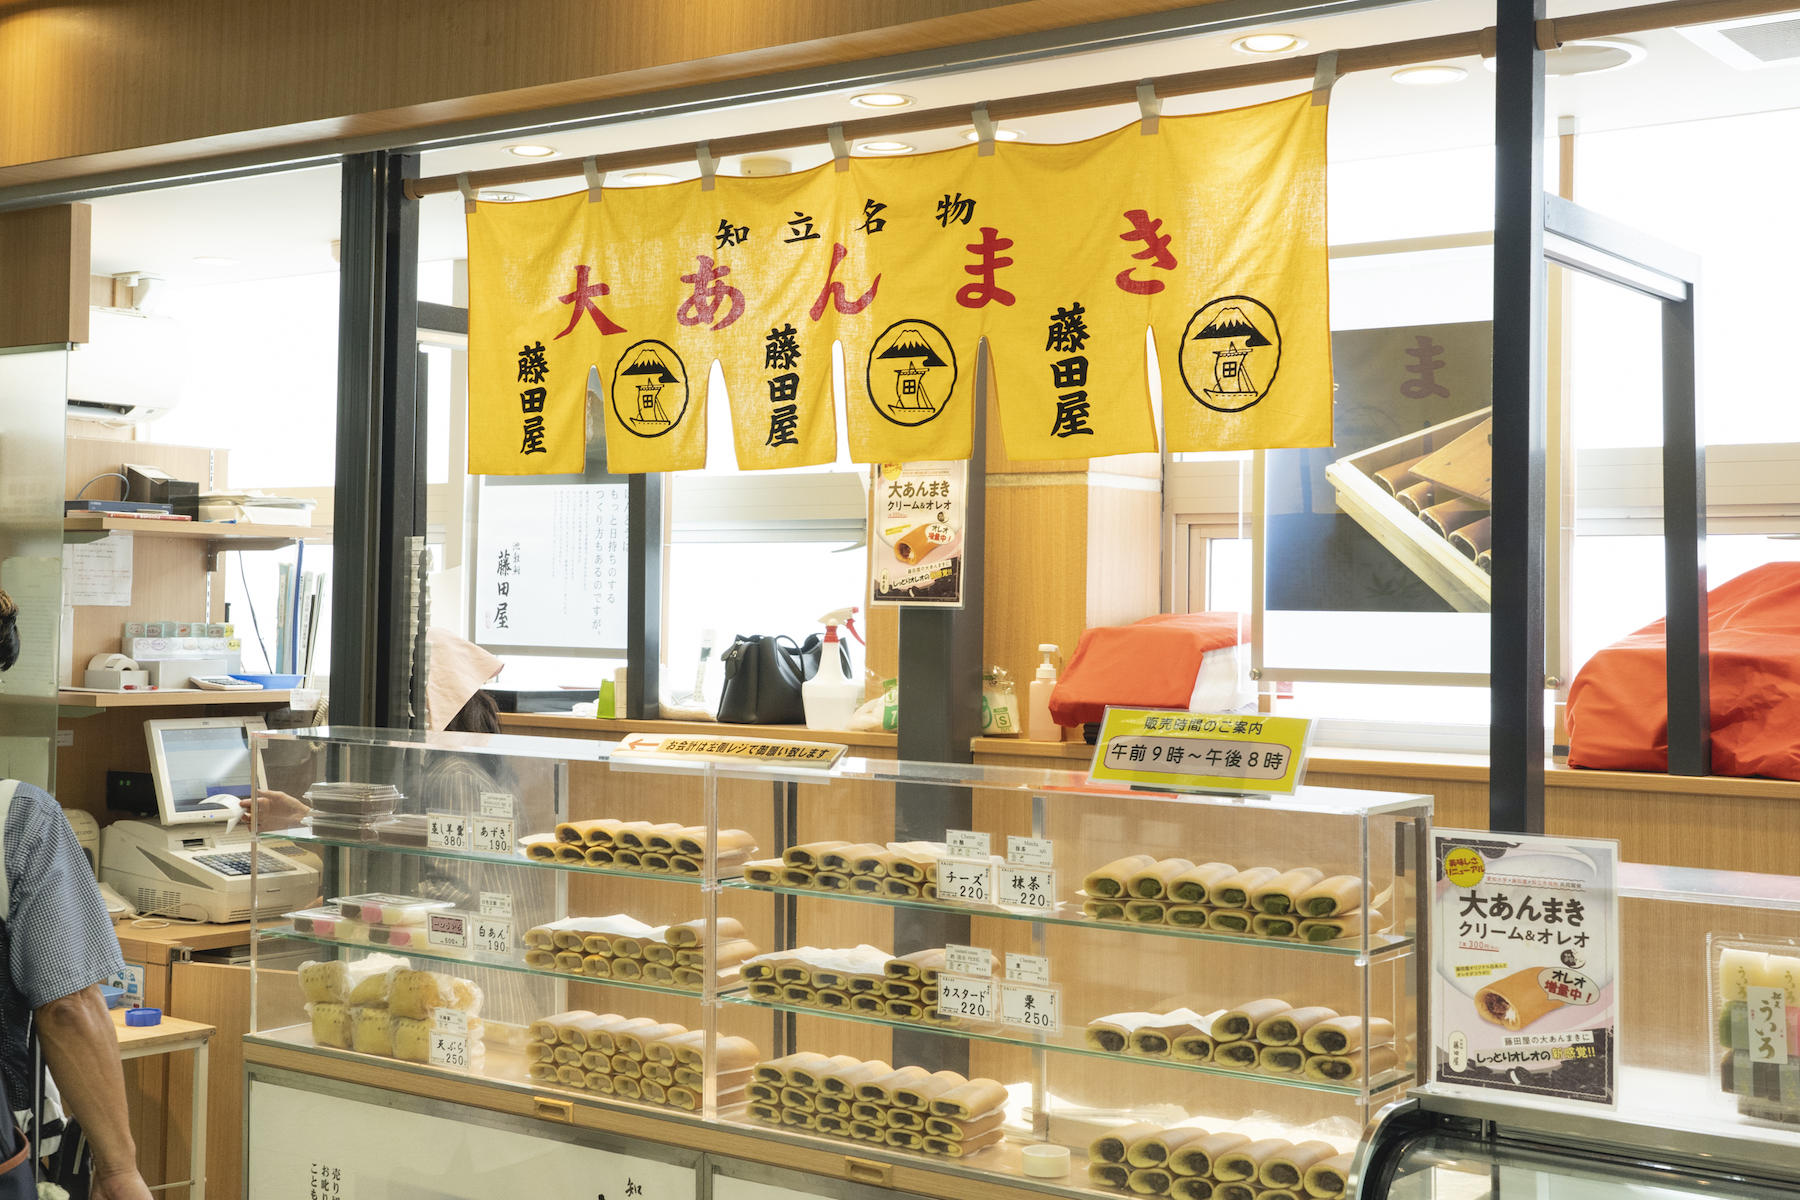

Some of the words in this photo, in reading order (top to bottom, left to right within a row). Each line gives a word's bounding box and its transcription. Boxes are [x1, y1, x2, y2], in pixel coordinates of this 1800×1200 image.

[714, 192, 976, 250] 知立名物
[553, 209, 1178, 341] 大あんまき
[1045, 302, 1094, 438] 藤田屋
[1400, 335, 1450, 400] ま
[764, 323, 802, 448] 藤田屋
[517, 341, 549, 456] 藤田屋
[888, 481, 950, 498] 大あんまき
[888, 500, 952, 511] クリーム&オレオ
[931, 525, 949, 533] オレオ
[493, 549, 512, 630] 藤田屋
[1143, 716, 1263, 735] 販売時間のご案内
[665, 740, 831, 759] お会計は左側レジで御願い致します
[480, 827, 506, 839] あずき
[444, 835, 462, 847] 380
[489, 840, 507, 851] 190
[946, 871, 983, 886] チーズ
[1012, 875, 1040, 891] 抹茶
[960, 885, 983, 899] 220
[1020, 892, 1045, 907] 220
[1459, 890, 1585, 927] 大あんまき
[479, 925, 505, 939] 白あん
[1459, 920, 1590, 948] クリーム&オレオ
[488, 940, 505, 952] 190
[1552, 970, 1587, 989] オレオ
[942, 985, 986, 1003] カスタード
[1544, 980, 1592, 1003] 増量中!
[961, 1001, 985, 1016] 220
[1024, 995, 1035, 1009] 栗
[1024, 1011, 1049, 1026] 250
[436, 1039, 464, 1053] 天ぷら
[1504, 1033, 1591, 1046] 藤田屋の大あんまきに
[446, 1053, 464, 1066] 250
